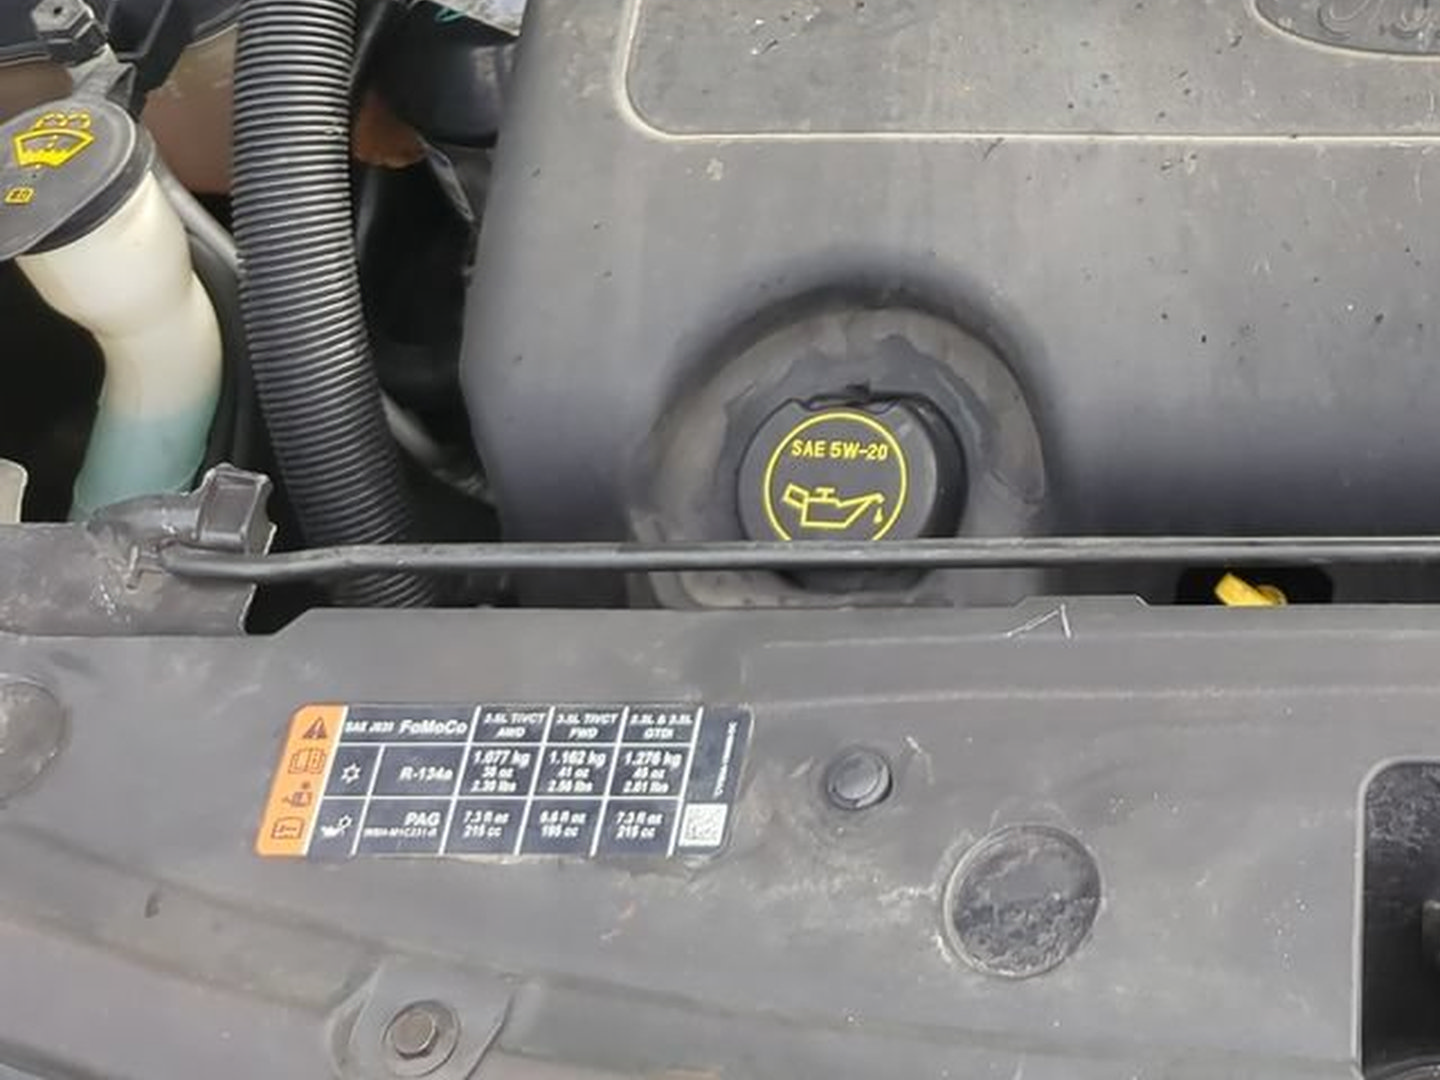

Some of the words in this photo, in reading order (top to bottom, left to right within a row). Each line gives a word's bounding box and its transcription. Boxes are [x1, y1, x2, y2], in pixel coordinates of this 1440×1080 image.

[792, 440, 826, 458] SAE
[830, 441, 889, 461] 5W-20
[399, 719, 468, 736] FoMoCo
[511, 749, 531, 769] kg
[586, 749, 606, 769] kg
[662, 750, 683, 769] kg
[400, 766, 453, 781] R-134a
[498, 767, 514, 779] oz
[574, 767, 590, 779] oz
[650, 768, 666, 780] oz
[404, 812, 441, 827] PAG
